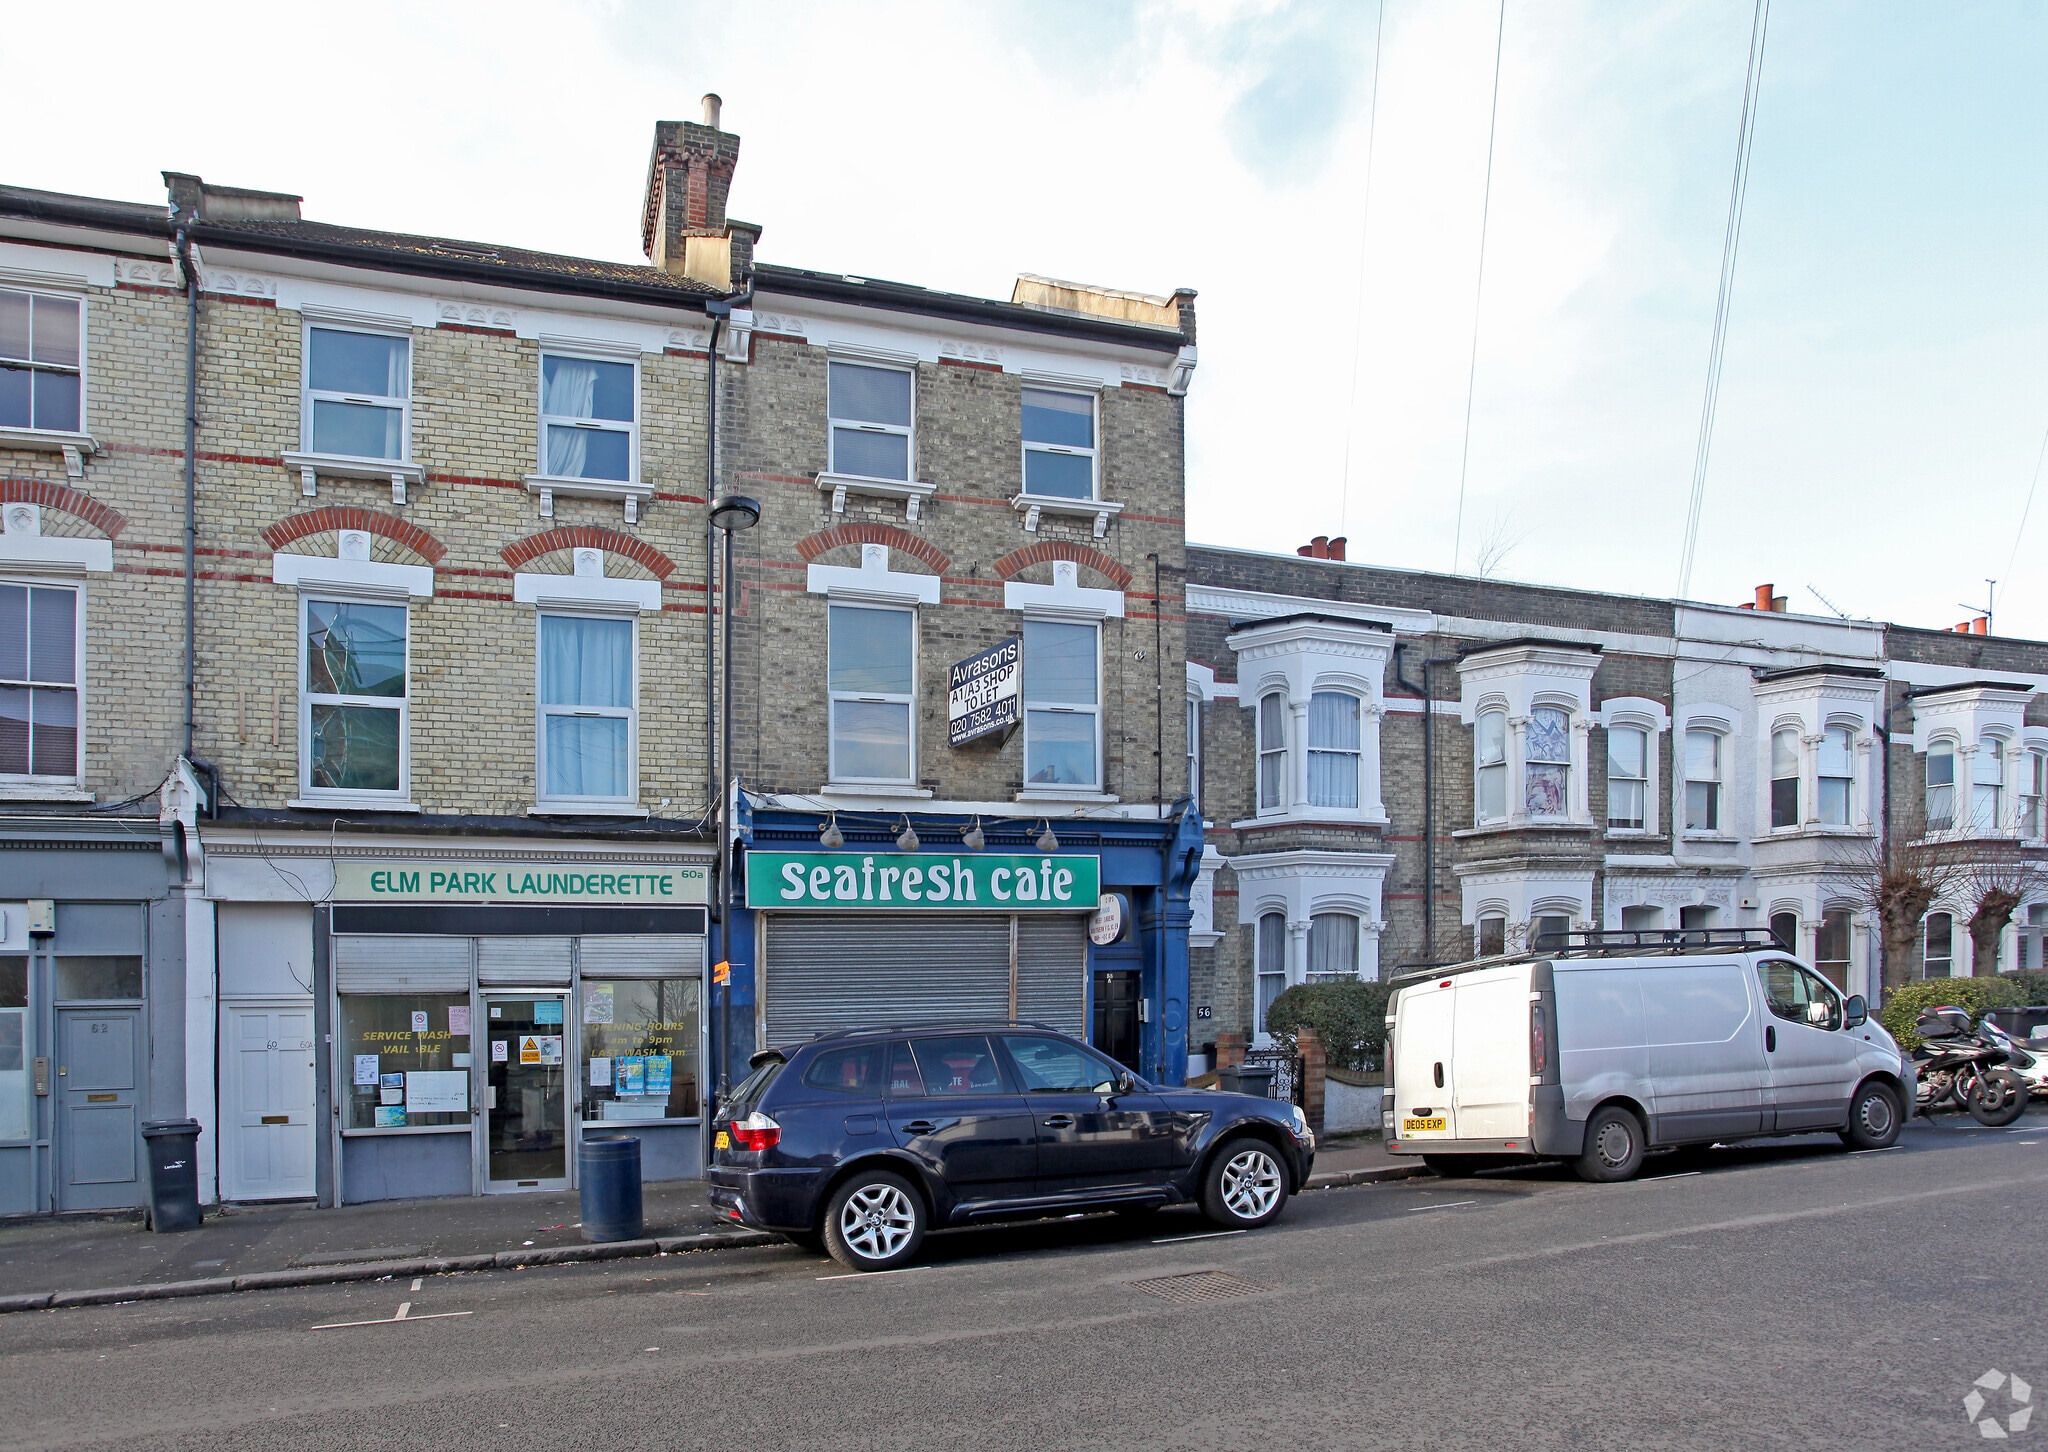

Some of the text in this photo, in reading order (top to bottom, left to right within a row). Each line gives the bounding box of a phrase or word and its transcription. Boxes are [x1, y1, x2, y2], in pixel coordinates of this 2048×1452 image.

[951, 643, 1016, 687] Avrasons
[951, 664, 1014, 704] A1/A3 SHOP
[964, 685, 999, 712] TO LET
[951, 696, 1016, 735] 020 7582 4011
[951, 712, 1014, 743] www.avrasons.co.uk
[681, 870, 704, 879] 60a
[780, 856, 1073, 901] Seafresh cafe
[370, 871, 673, 895] ELM PARK LAUNDERETTE
[1198, 1007, 1211, 1018] 56
[91, 1023, 108, 1034] 62
[592, 1021, 684, 1032] OPENING HOURS
[362, 1030, 452, 1041] SERVICE WASH
[632, 1034, 644, 1044] to
[649, 1035, 673, 1045] 9pm
[266, 1040, 278, 1050] 60
[591, 1049, 619, 1058] LAST
[624, 1048, 657, 1057] WASH
[1406, 1119, 1442, 1130] DE05 EXP
